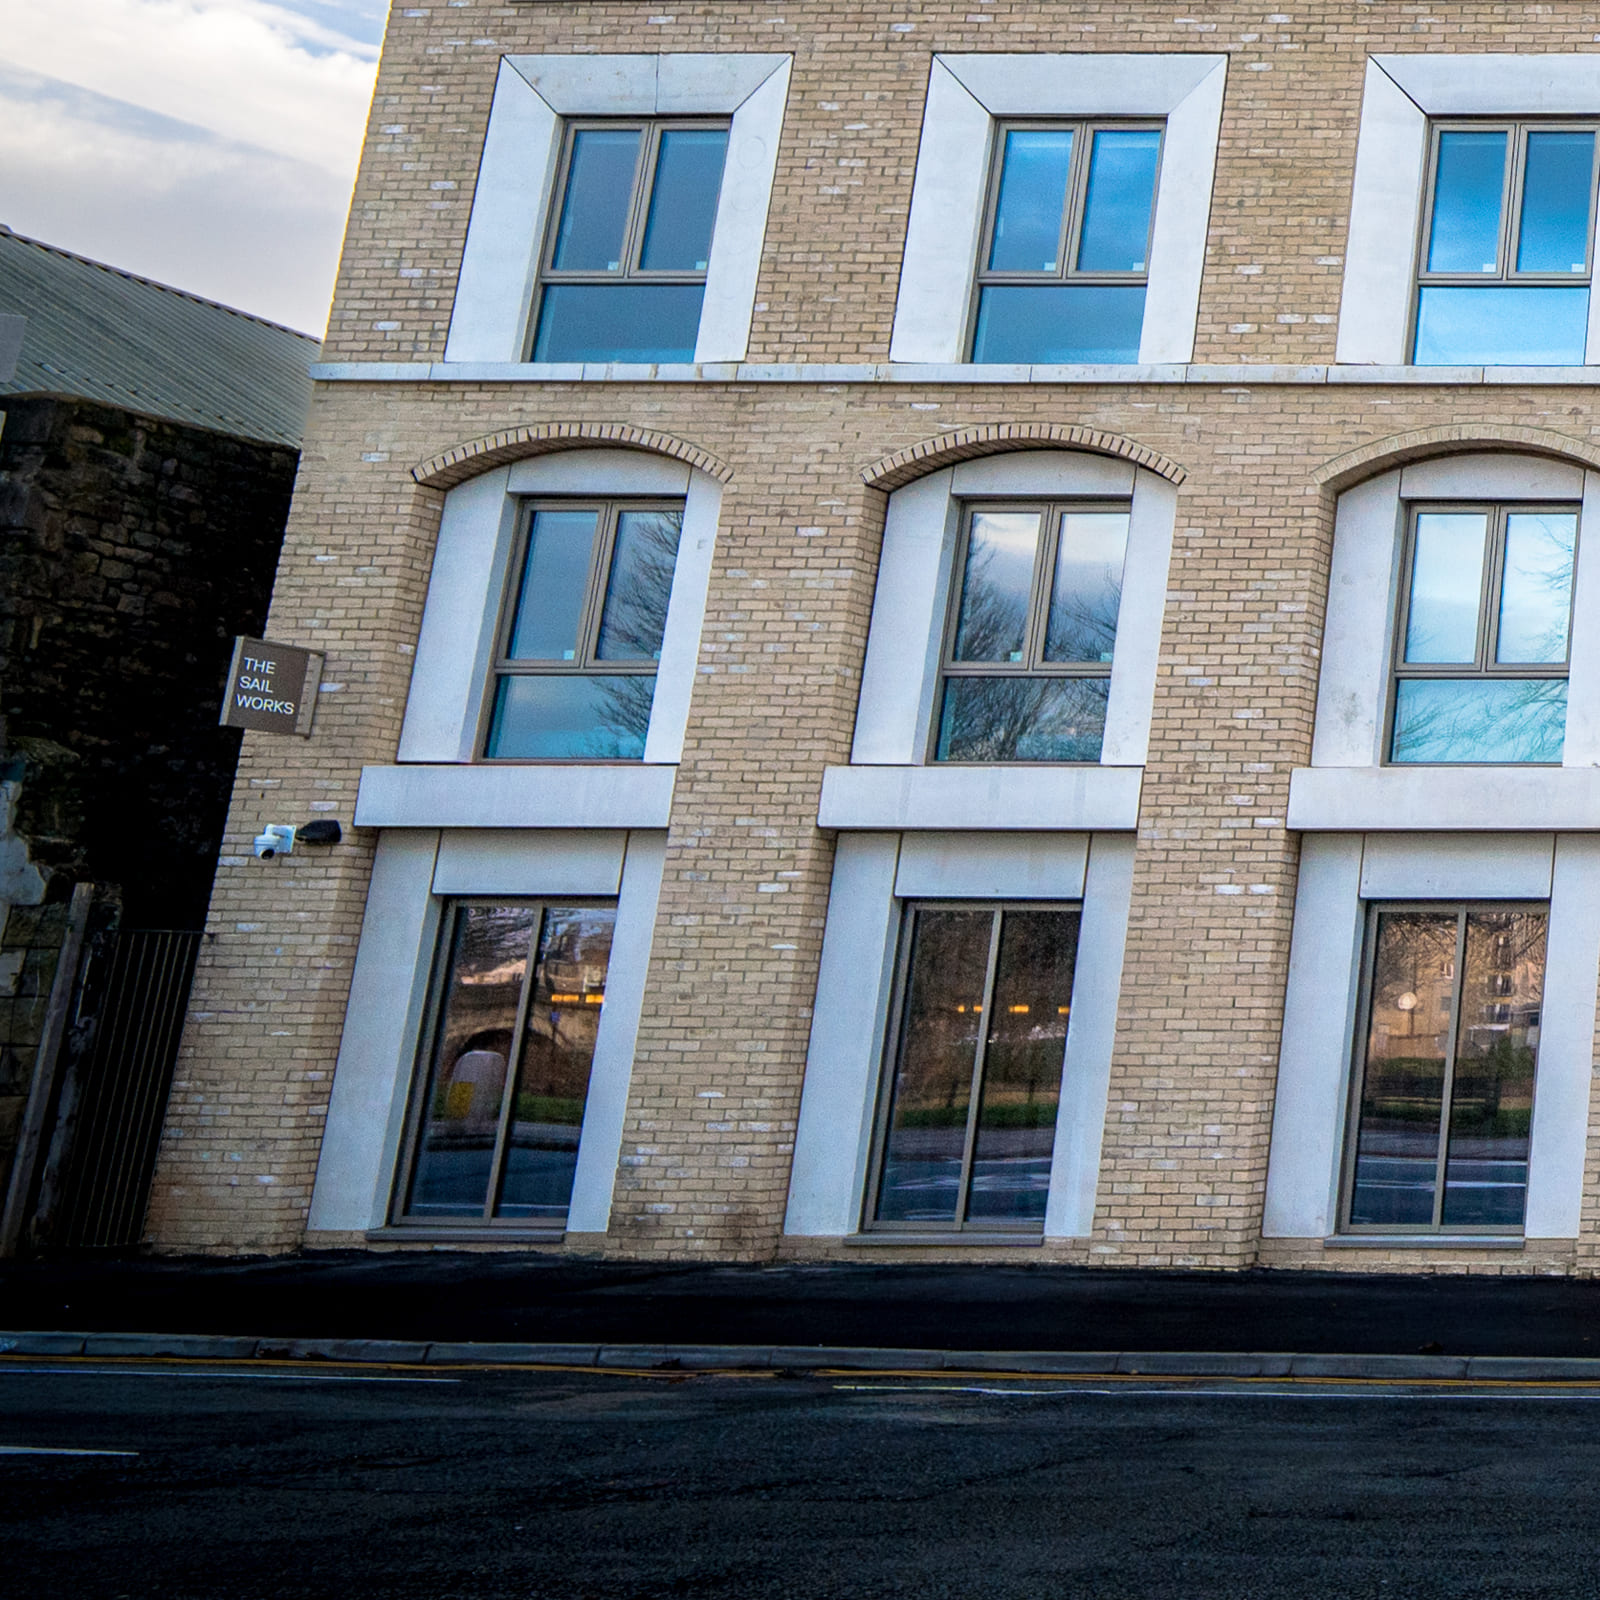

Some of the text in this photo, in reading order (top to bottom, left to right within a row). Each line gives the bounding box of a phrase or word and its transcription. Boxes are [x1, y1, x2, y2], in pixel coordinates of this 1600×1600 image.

[244, 657, 276, 675] THE
[240, 676, 274, 693] SAIL
[236, 694, 295, 715] WORKS
